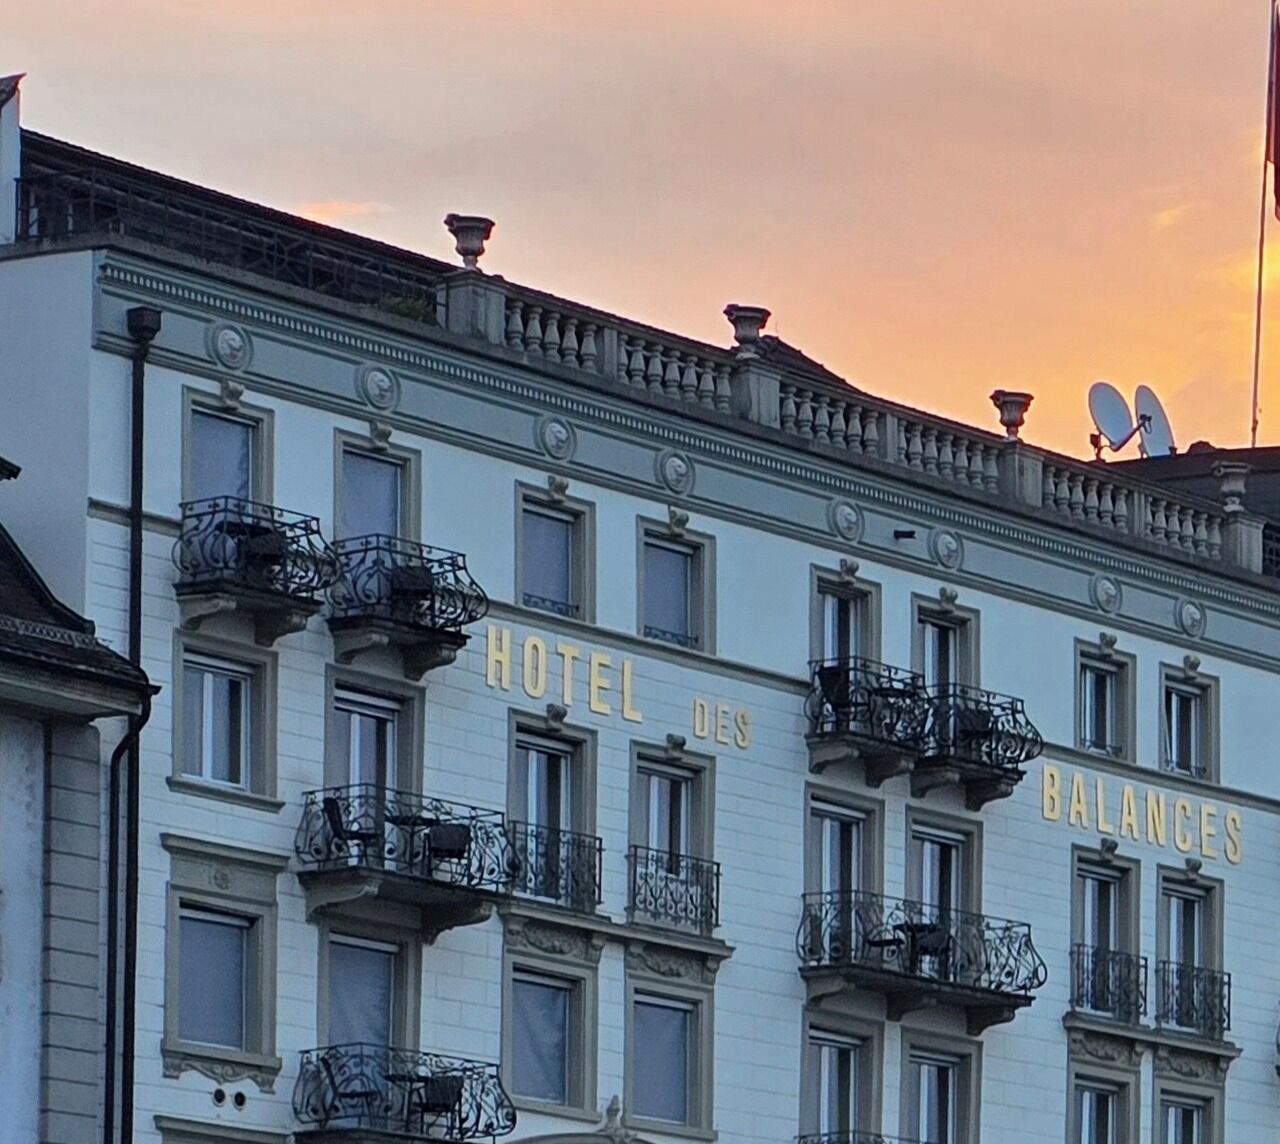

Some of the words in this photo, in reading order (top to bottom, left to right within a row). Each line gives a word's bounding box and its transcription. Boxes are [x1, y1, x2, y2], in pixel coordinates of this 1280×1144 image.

[485, 624, 644, 724] HOTEL
[691, 697, 753, 749] DES
[1039, 763, 1244, 865] BALANCES
